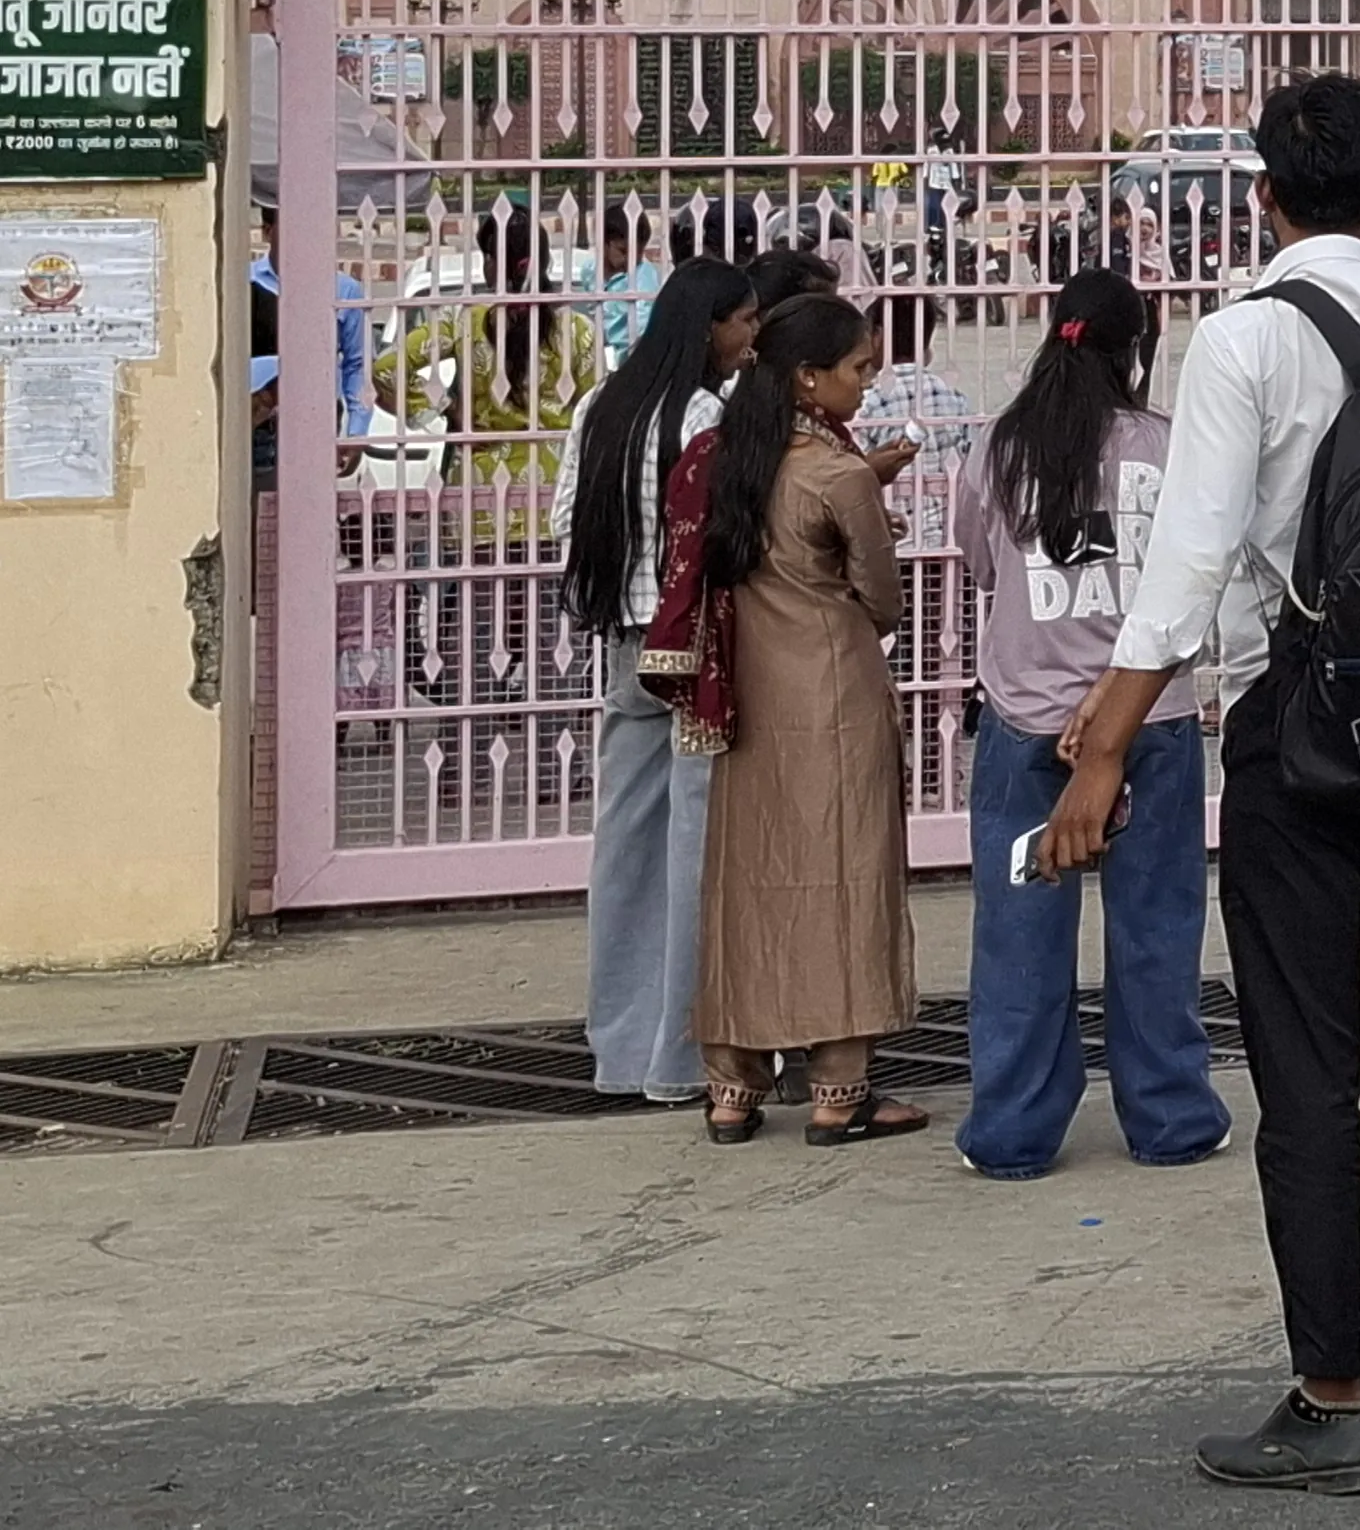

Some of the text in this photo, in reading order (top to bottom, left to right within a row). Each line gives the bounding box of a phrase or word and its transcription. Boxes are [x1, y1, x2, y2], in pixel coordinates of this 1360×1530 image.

[0, 44, 191, 98] जाजत नहीं
[5, 136, 54, 149] ₹2000
